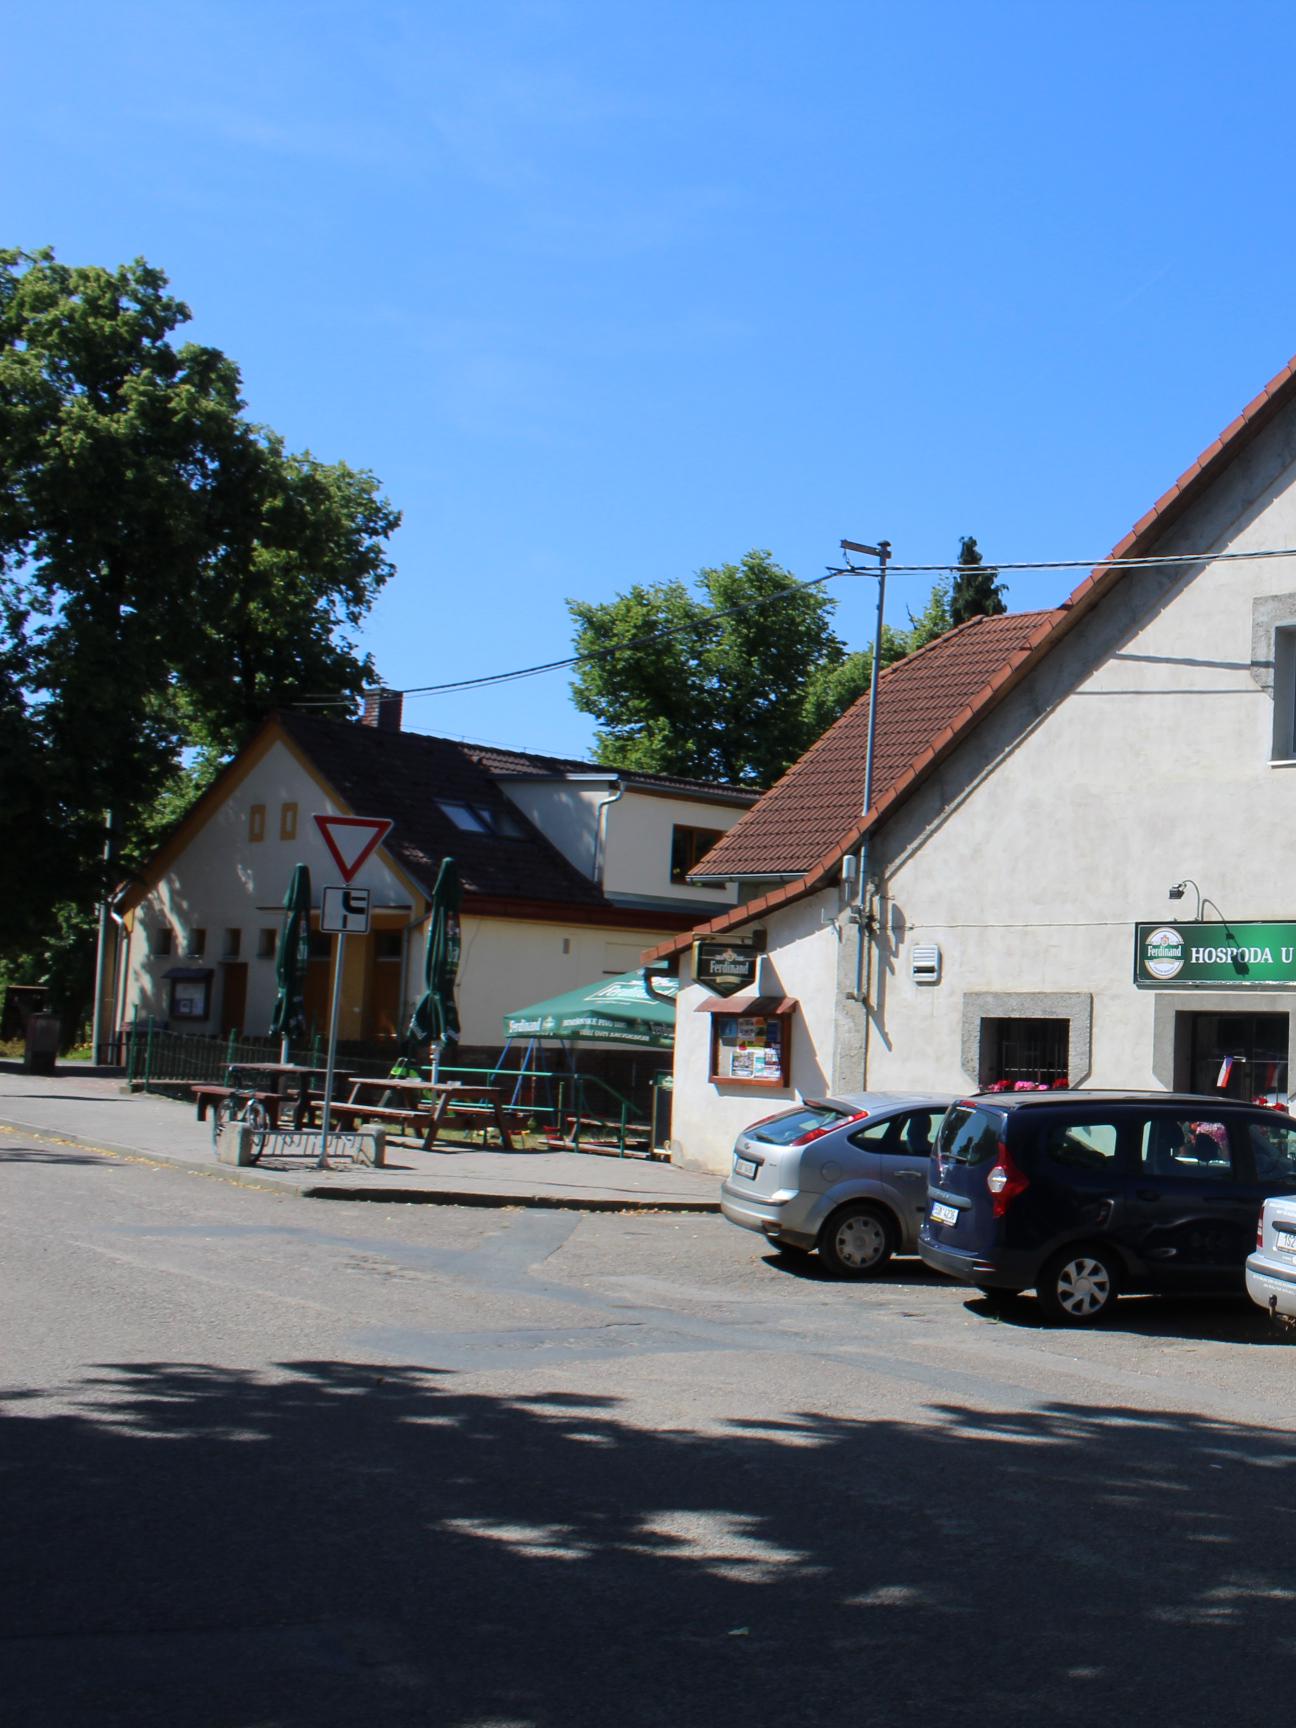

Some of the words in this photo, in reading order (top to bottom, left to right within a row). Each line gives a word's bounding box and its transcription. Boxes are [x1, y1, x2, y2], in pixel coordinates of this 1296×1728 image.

[1147, 945, 1182, 957] Ferdinand
[1190, 947, 1273, 964] HOSPODA
[1281, 947, 1294, 963] U
[710, 960, 749, 975] Ferdinand
